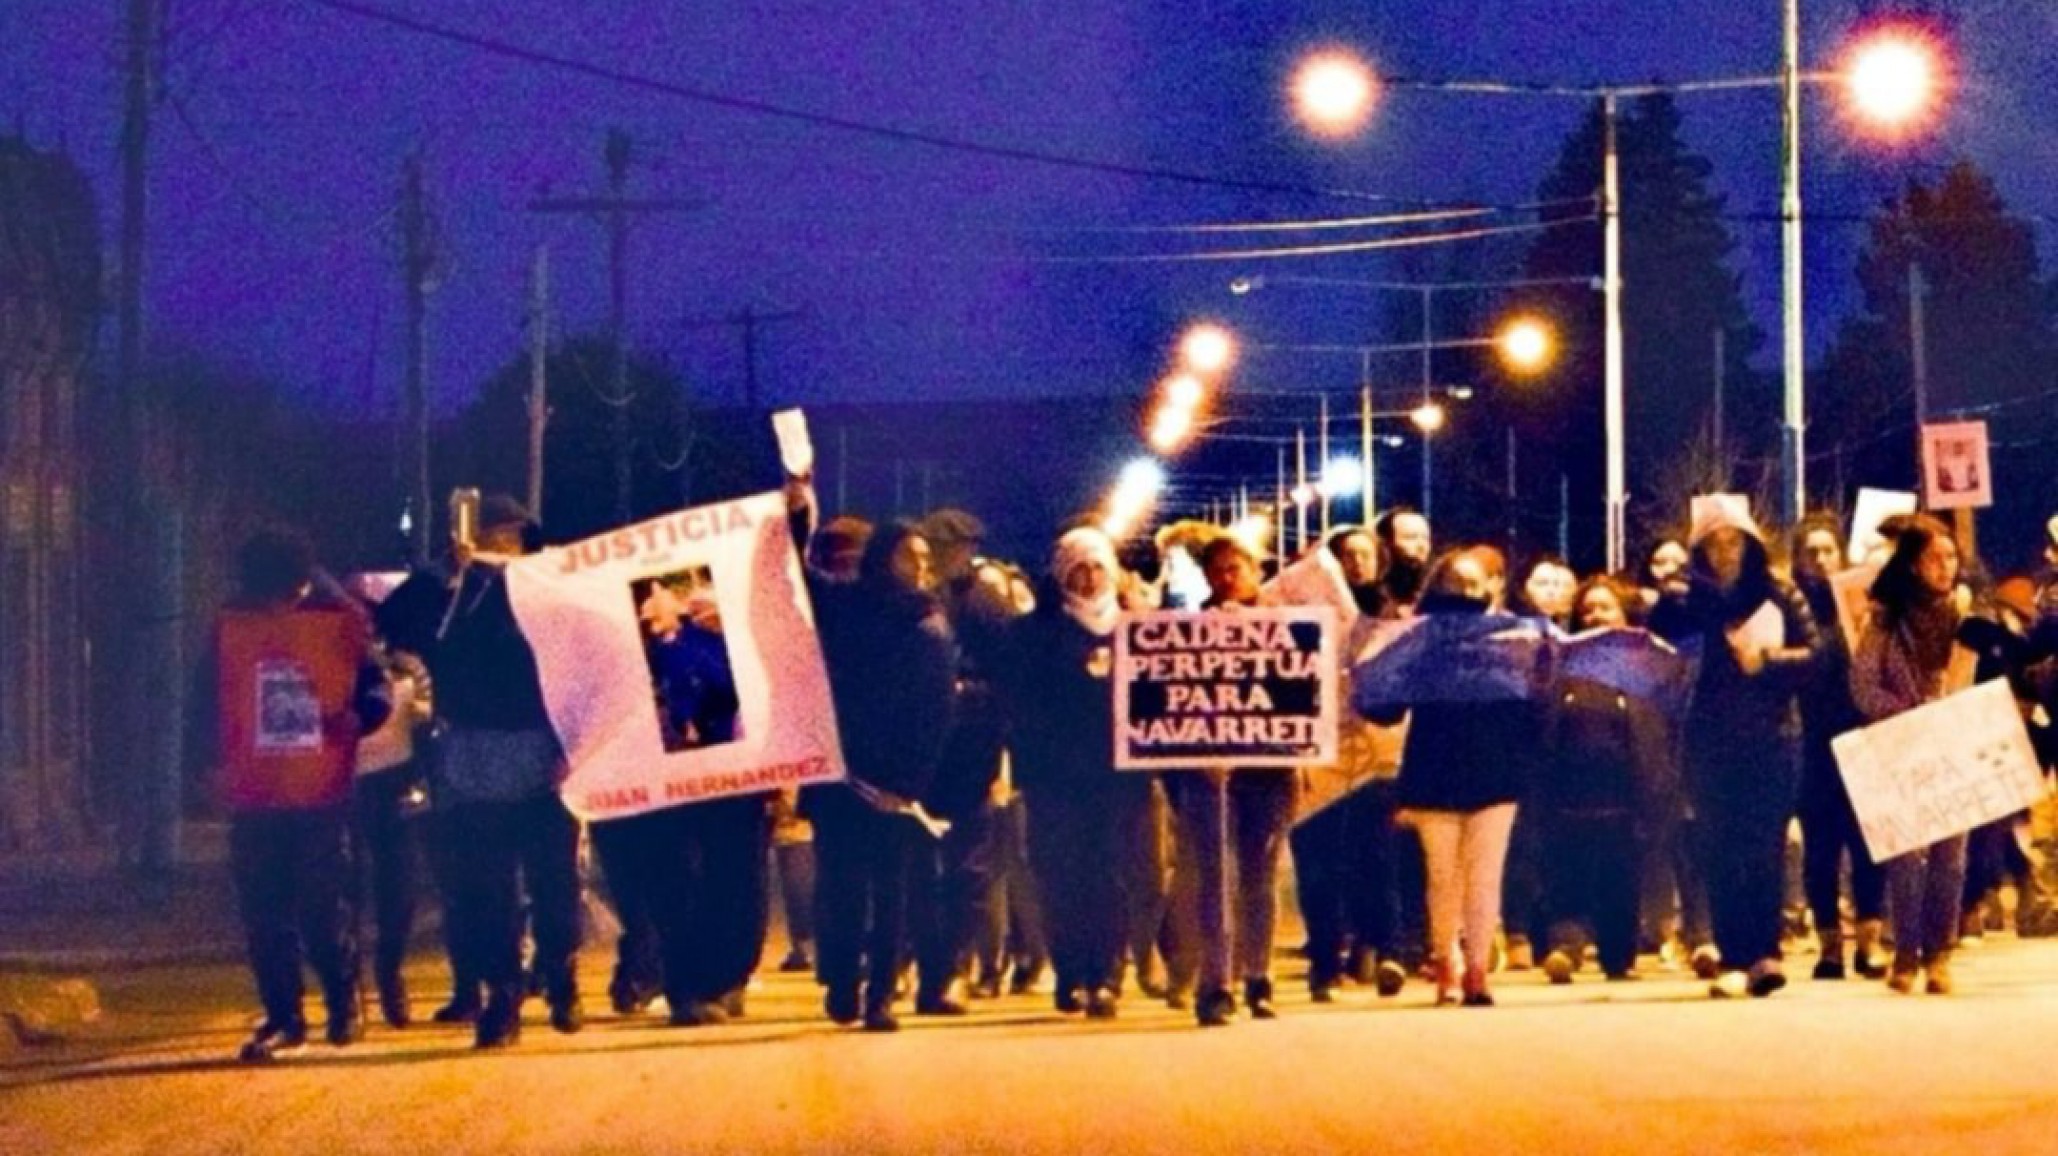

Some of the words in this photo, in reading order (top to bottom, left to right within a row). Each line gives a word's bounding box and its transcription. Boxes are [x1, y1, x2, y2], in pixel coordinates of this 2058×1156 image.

[559, 502, 754, 575] JUSTICIA
[1134, 619, 1298, 651] CADENA
[1128, 651, 1320, 680] PERPETUA
[1166, 684, 1275, 713] PARA
[664, 755, 832, 799] HERNANDEZ
